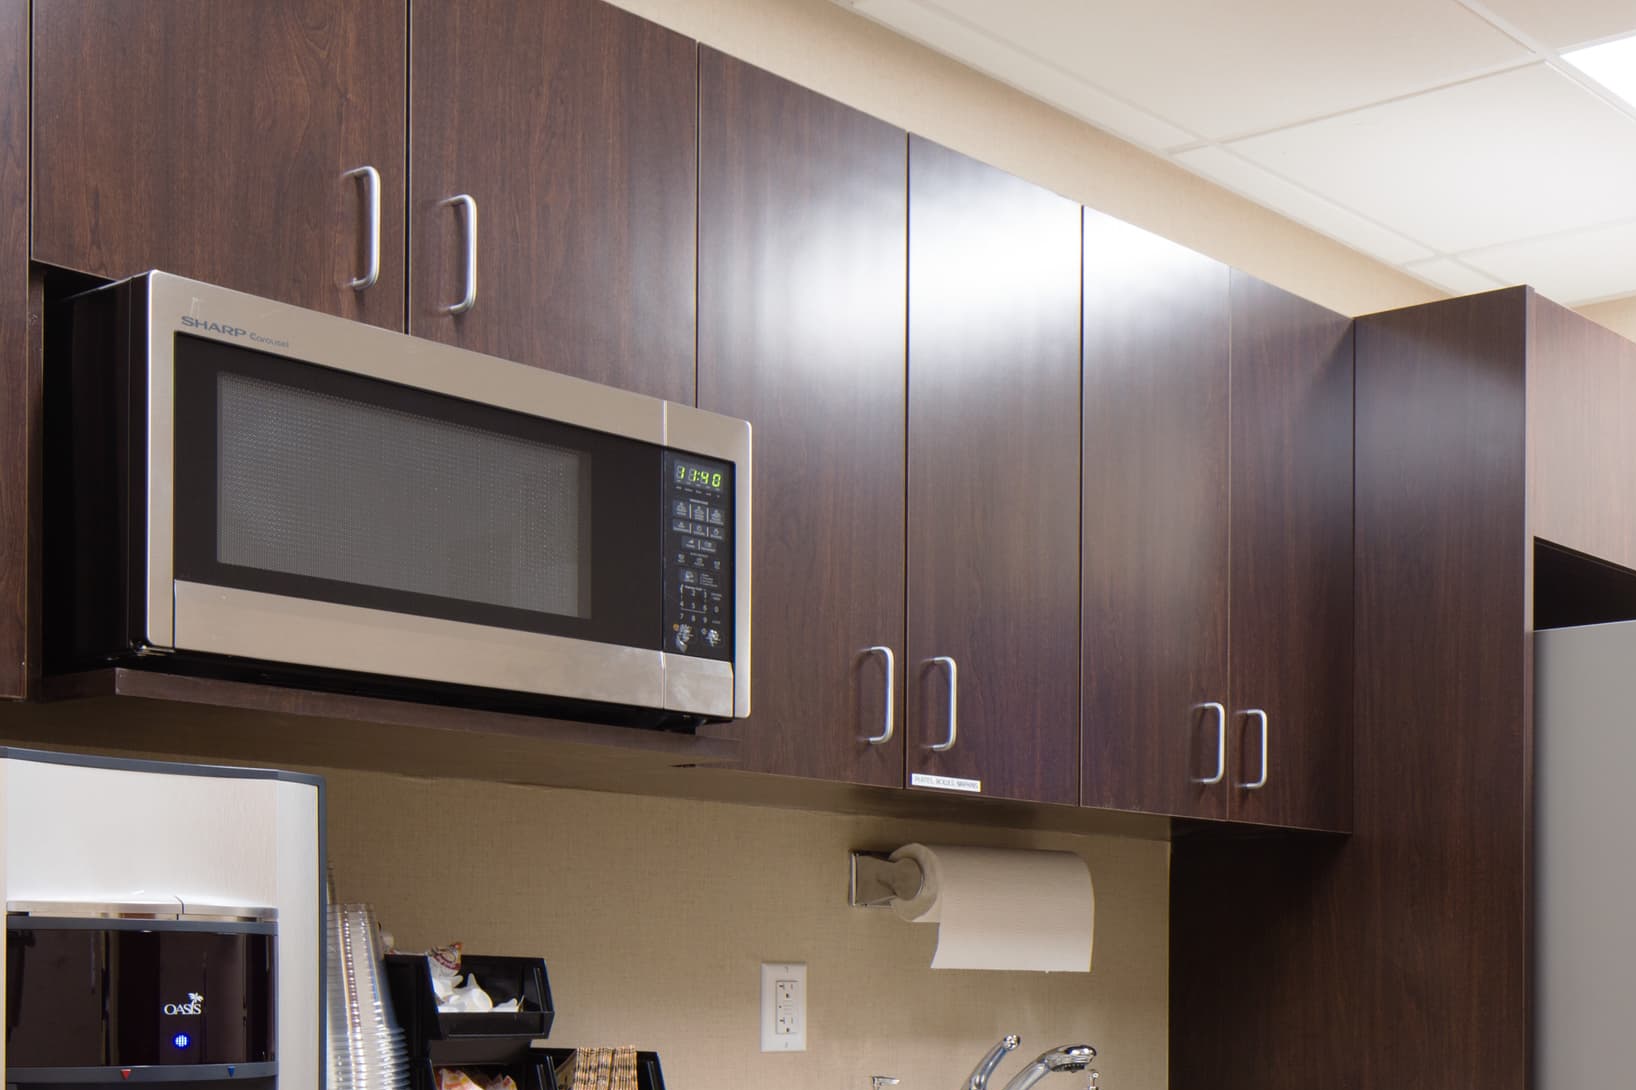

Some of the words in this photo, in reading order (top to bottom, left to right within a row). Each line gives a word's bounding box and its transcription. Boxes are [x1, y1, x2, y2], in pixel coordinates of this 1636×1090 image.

[181, 315, 247, 337] SHARP
[680, 466, 721, 488] 11:40
[164, 999, 202, 1015] OASIS
